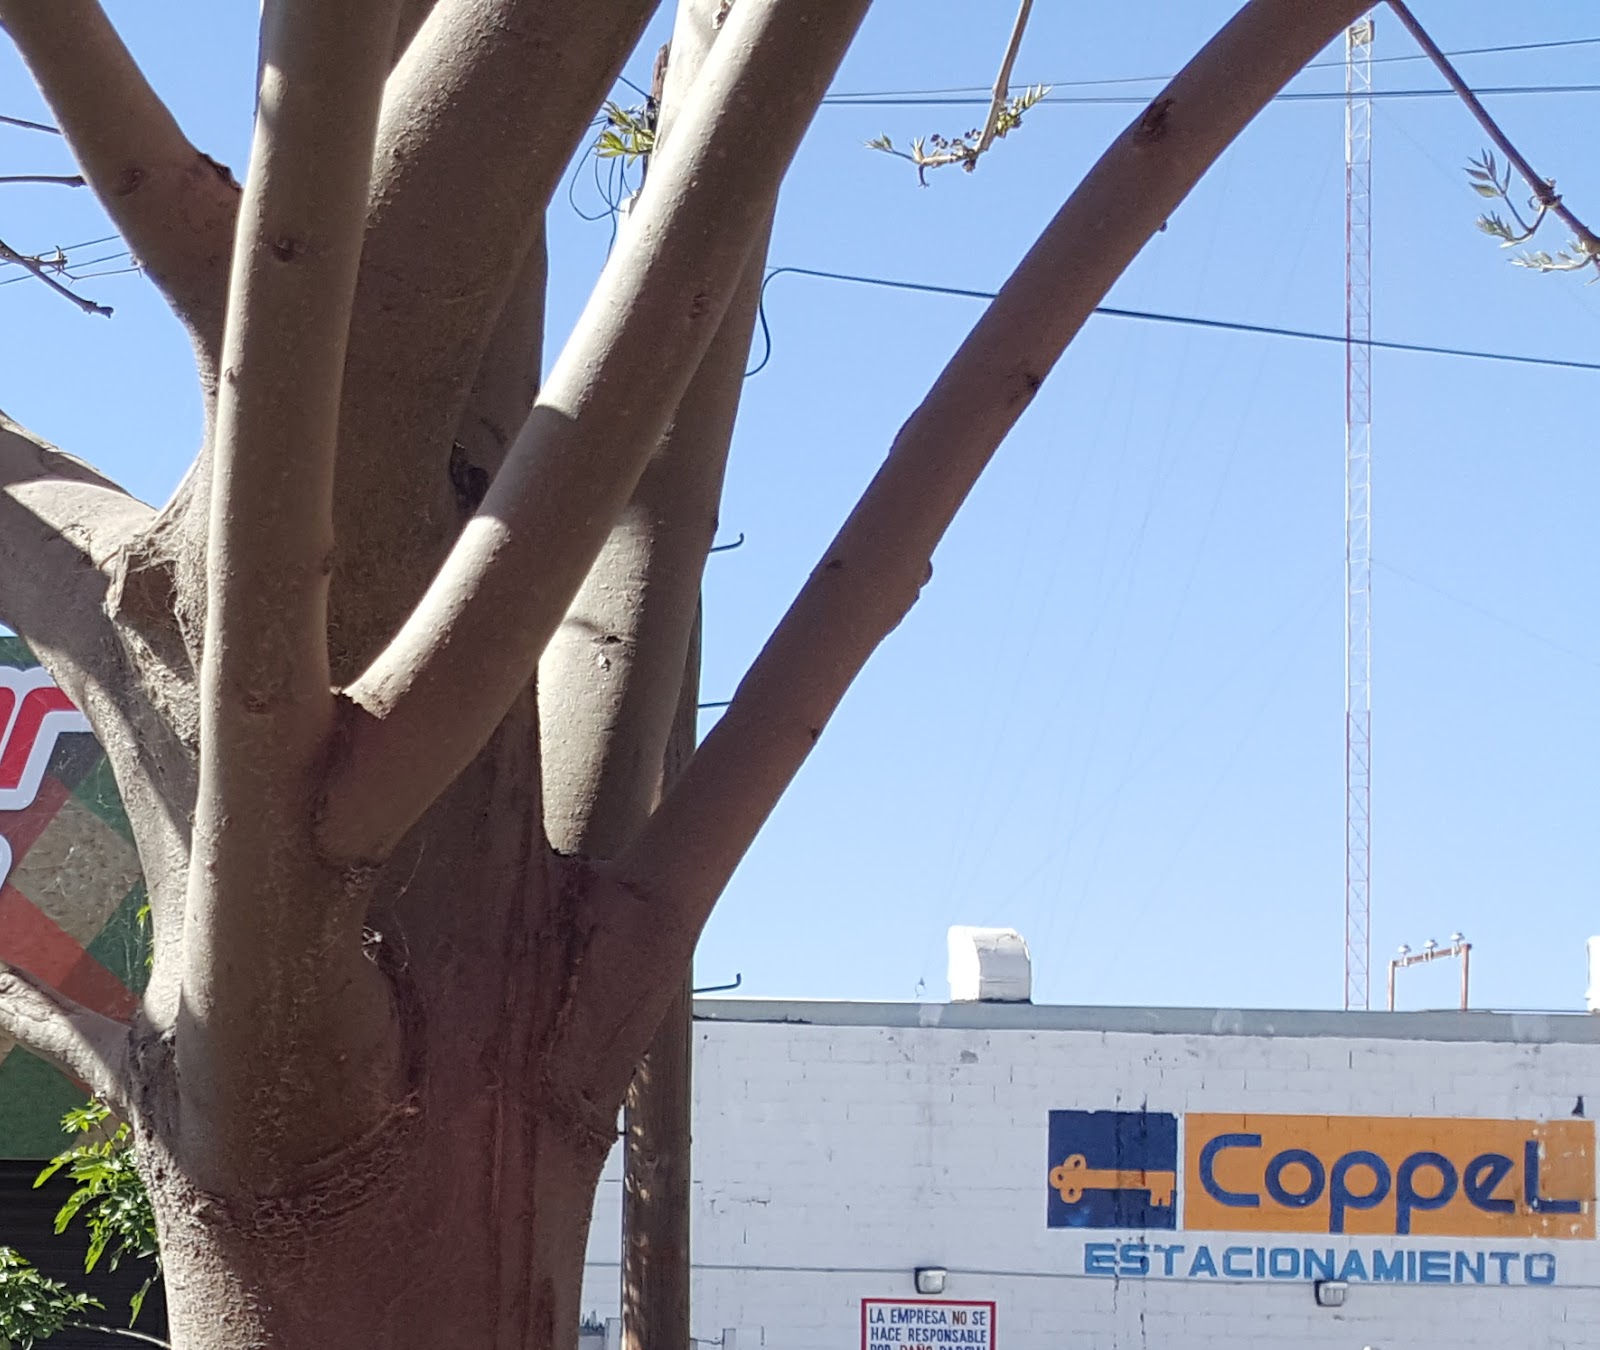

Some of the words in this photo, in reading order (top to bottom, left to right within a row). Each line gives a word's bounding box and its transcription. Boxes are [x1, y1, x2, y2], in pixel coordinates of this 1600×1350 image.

[1084, 1242, 1556, 1286] ESTACIONAMIENTO
[869, 1308, 885, 1324] LA
[890, 1308, 947, 1325] EMPRESA
[952, 1310, 967, 1326] NO
[972, 1310, 986, 1326] SE
[870, 1327, 901, 1342] HACE
[908, 1328, 987, 1343] RESPONSABLE
